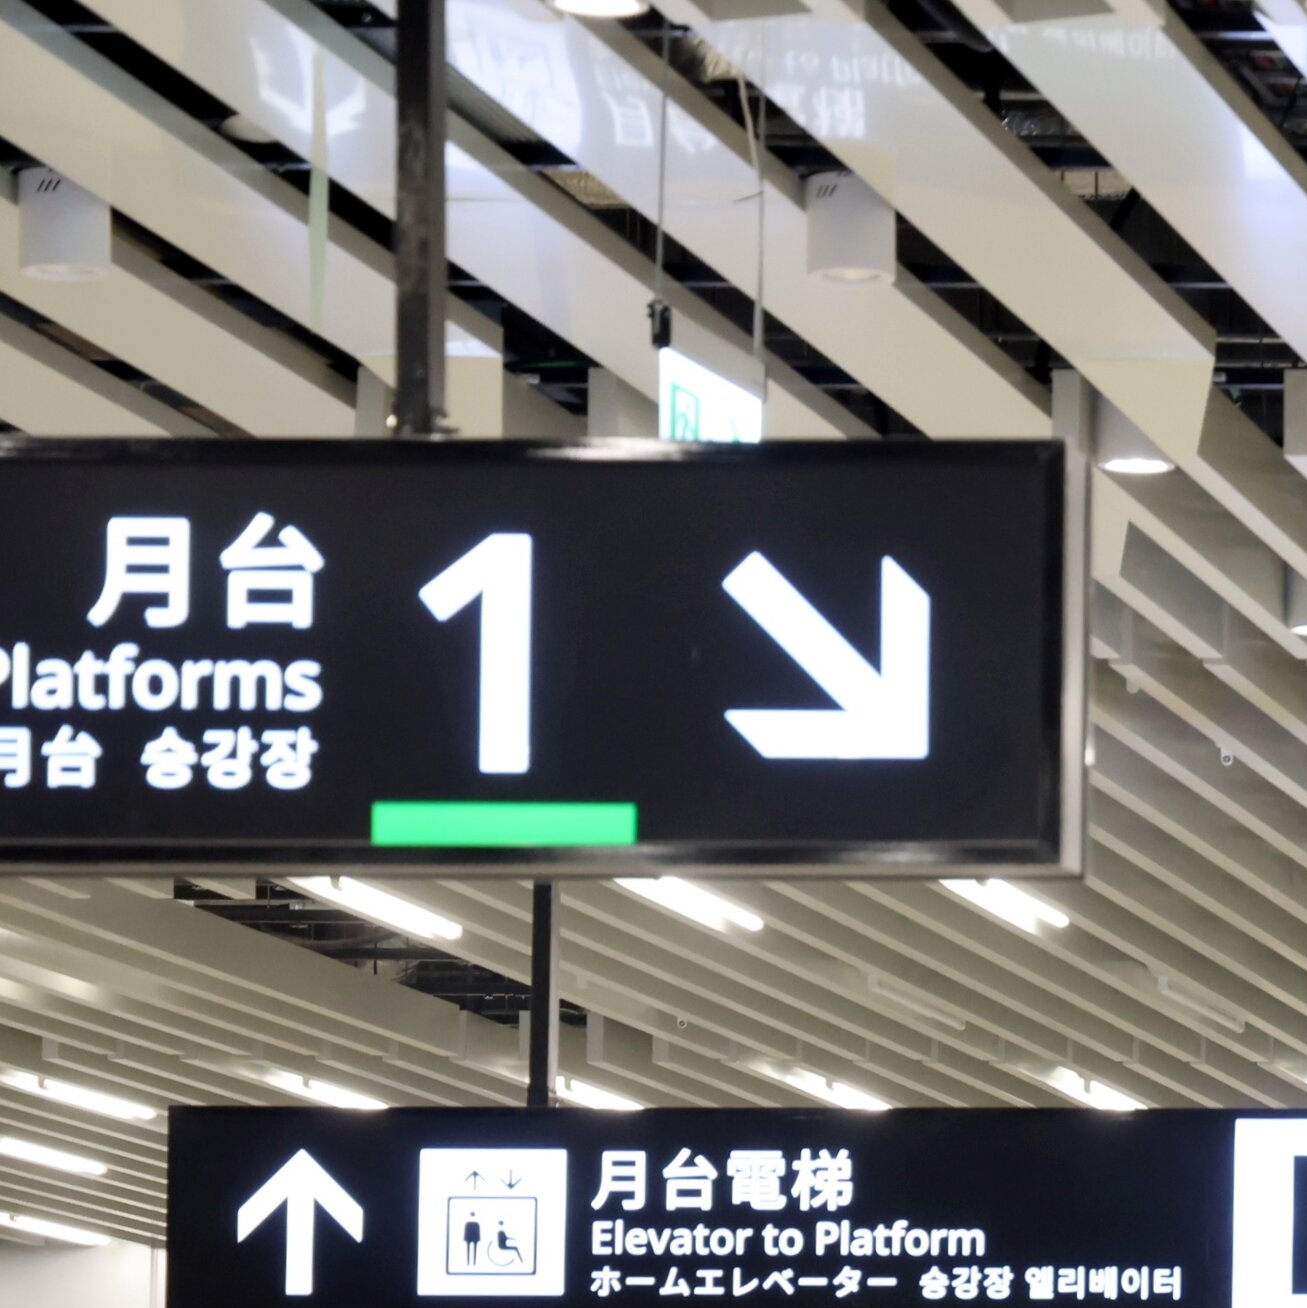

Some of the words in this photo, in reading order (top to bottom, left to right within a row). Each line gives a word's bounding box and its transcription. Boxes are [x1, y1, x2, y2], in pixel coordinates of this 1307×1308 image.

[87, 512, 324, 629] 月台
[418, 533, 532, 774] 1
[141, 726, 318, 789] 승강장
[591, 1148, 853, 1211] 月台電梯
[592, 1219, 753, 1256] Elevator
[762, 1224, 804, 1257] to
[816, 1219, 985, 1257] Platform
[590, 1266, 897, 1299] ホームエレベーター
[919, 1266, 1014, 1299] 승강장
[1025, 1266, 1181, 1300] 엘리베이터
